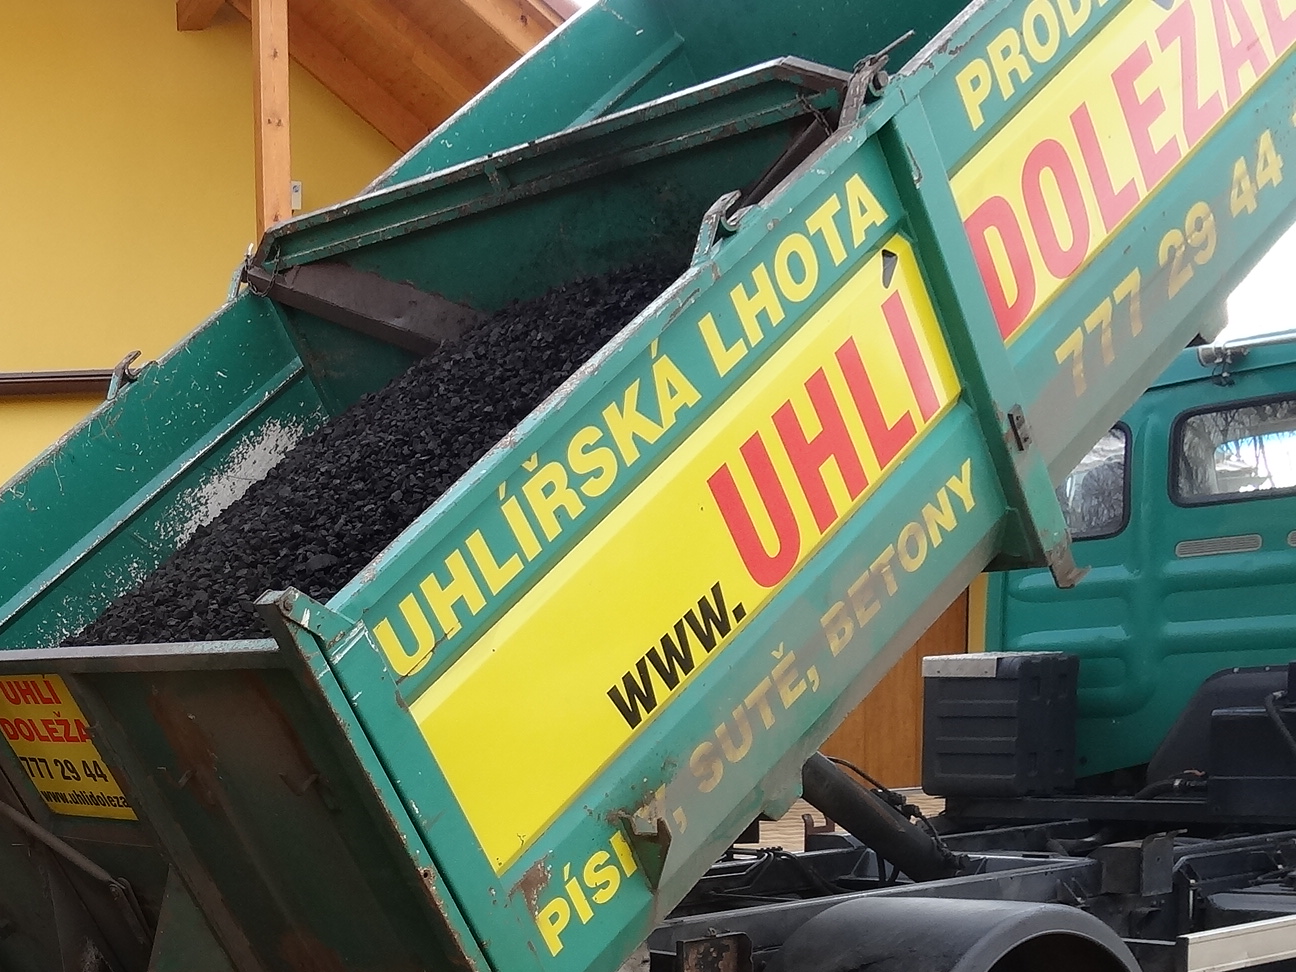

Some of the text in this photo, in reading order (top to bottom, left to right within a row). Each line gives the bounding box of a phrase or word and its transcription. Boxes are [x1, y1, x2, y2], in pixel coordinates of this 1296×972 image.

[372, 173, 889, 677] UHLÍŘSKÁ LHOTA
[1054, 129, 1284, 397] 777 29 44
[606, 249, 941, 730] www. UHLÍ
[689, 641, 821, 793] SUTĚ,
[820, 458, 976, 658] BETONY
[19, 756, 108, 783] 777 29 44
